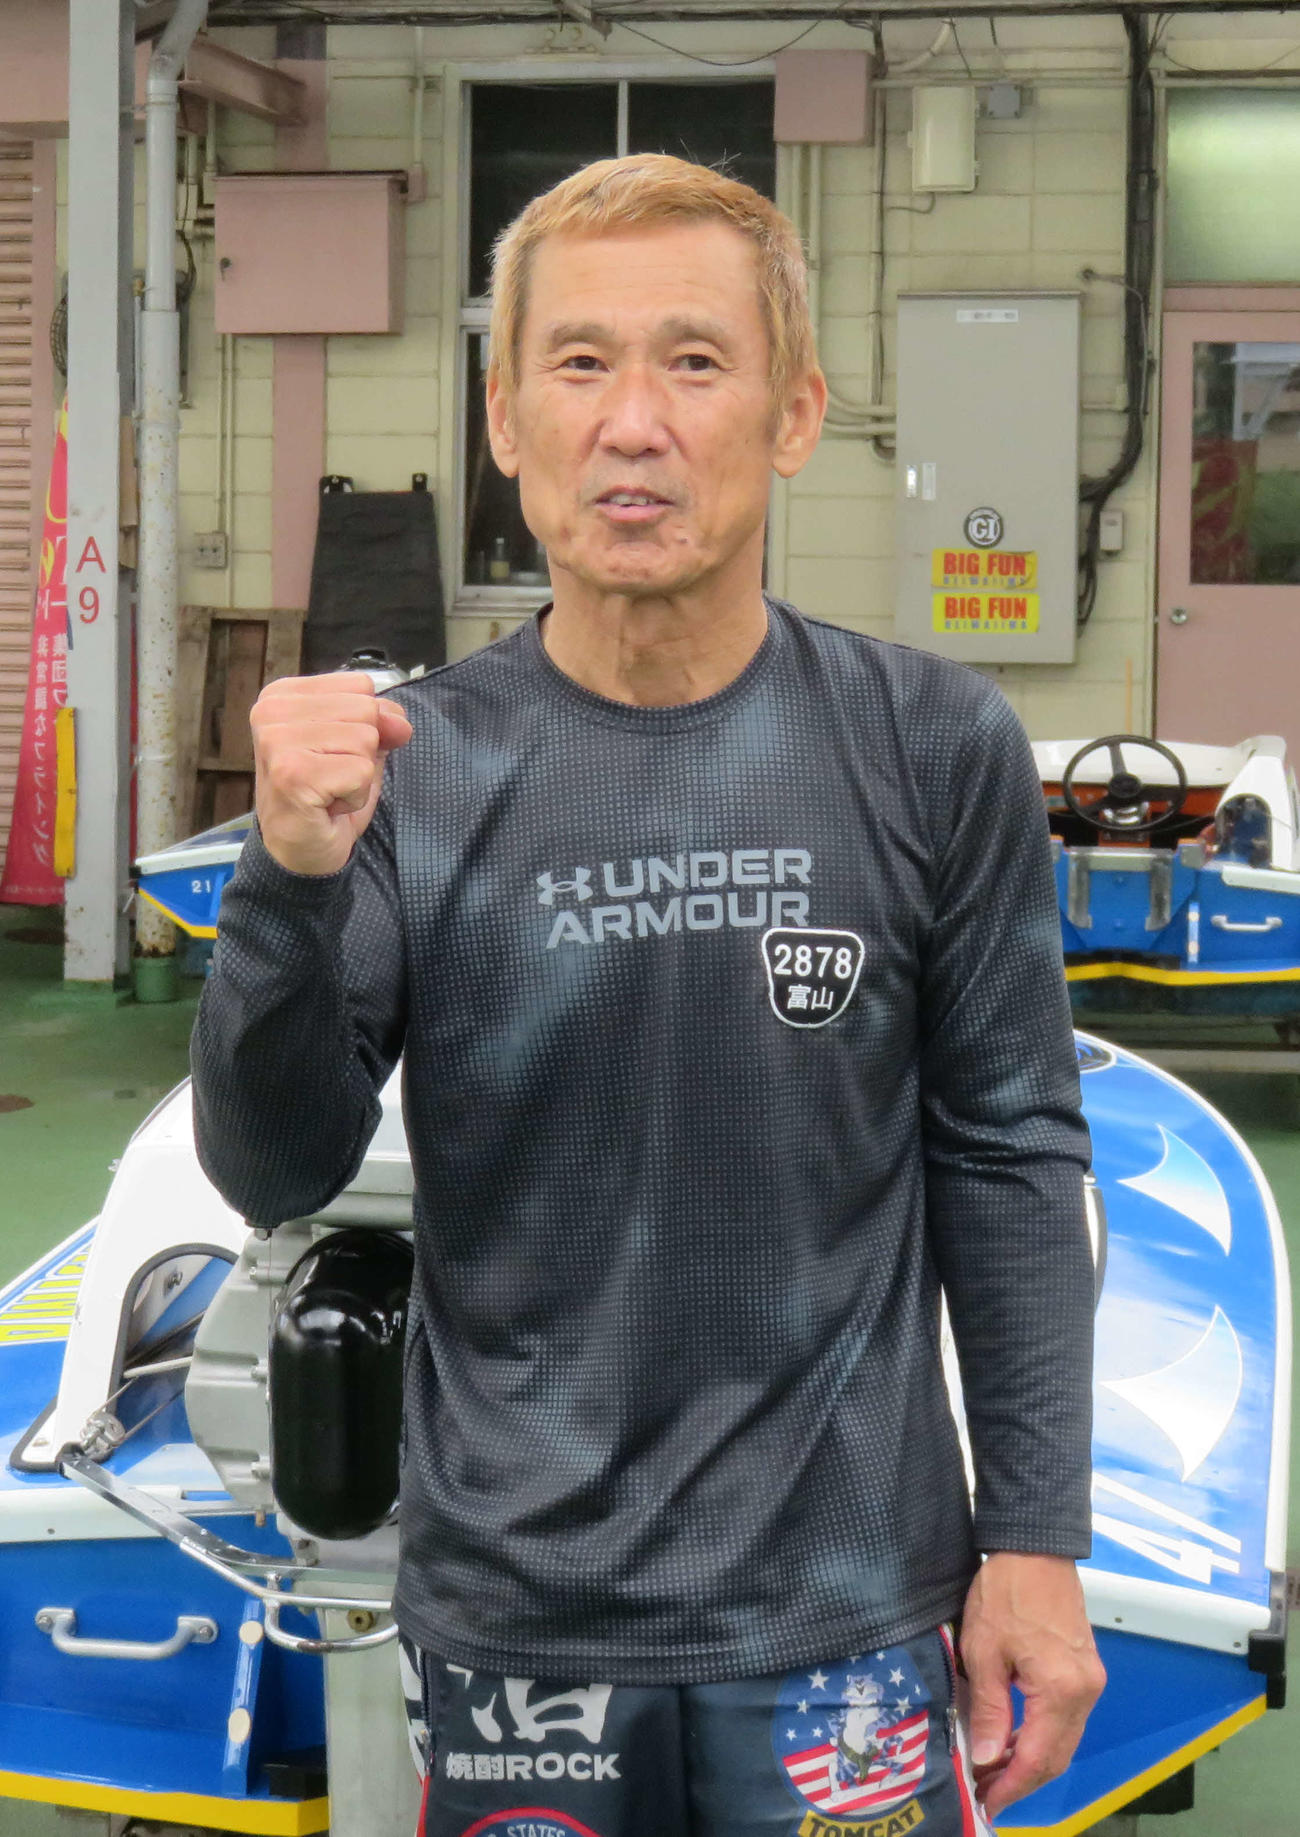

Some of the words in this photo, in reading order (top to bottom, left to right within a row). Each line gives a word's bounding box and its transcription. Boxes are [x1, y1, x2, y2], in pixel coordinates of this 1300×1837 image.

[75, 536, 107, 573] A
[944, 553, 980, 575] BIG
[987, 553, 1026, 576] FUN
[79, 586, 100, 624] 9
[945, 597, 981, 619] BIG
[988, 597, 1027, 619] FUN
[191, 880, 211, 894] 21
[603, 849, 812, 898] UNDER
[546, 891, 810, 949] ARMOUR
[774, 943, 852, 979] 2878
[787, 984, 834, 1010] 富山
